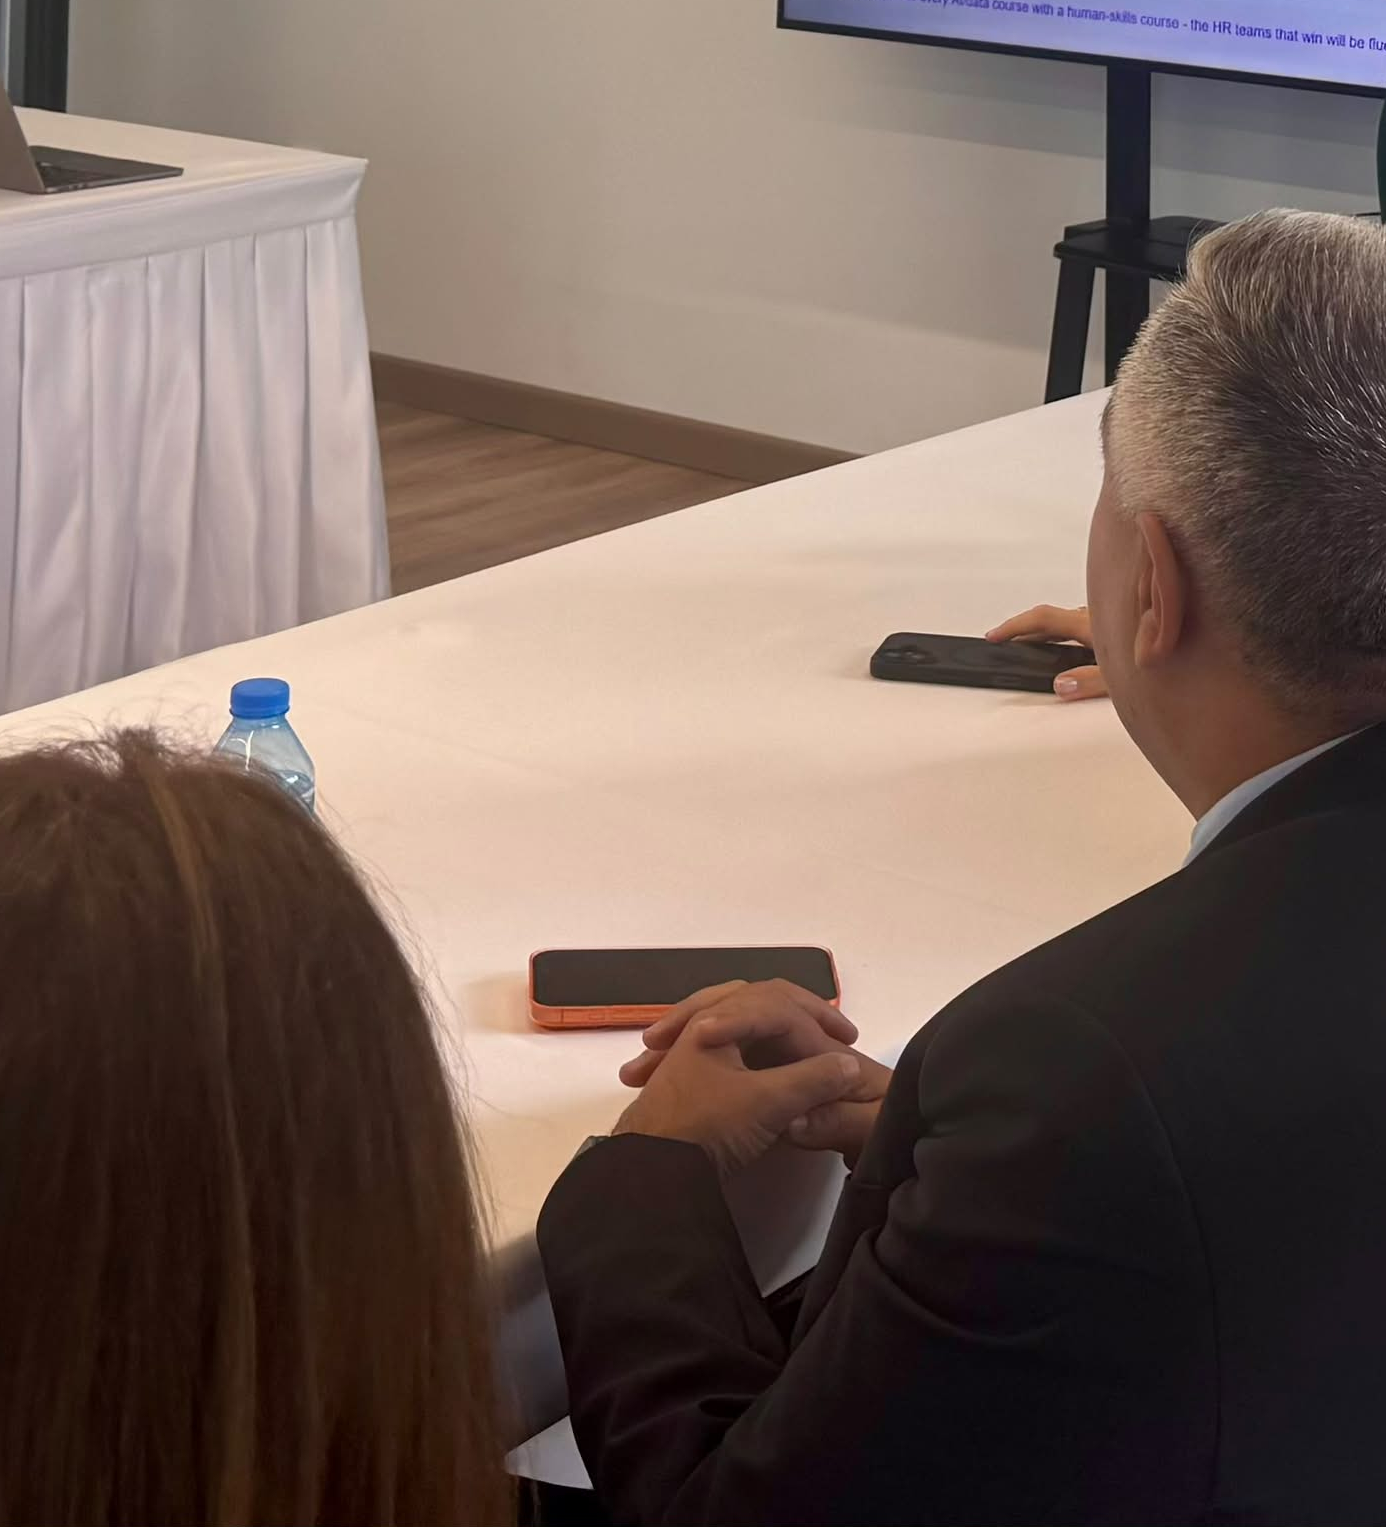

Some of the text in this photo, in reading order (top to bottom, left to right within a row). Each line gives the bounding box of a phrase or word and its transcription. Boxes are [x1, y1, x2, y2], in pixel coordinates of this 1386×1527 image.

[992, 0, 1029, 13] course
[1032, 4, 1053, 16] with
[1057, 6, 1064, 17] a
[1067, 6, 1137, 24] human-skills
[1140, 15, 1179, 29] course
[1190, 19, 1209, 32] the
[1213, 20, 1231, 35] HR
[1235, 24, 1272, 39] teams
[1275, 28, 1298, 42] that
[1301, 33, 1323, 44] win
[1349, 35, 1365, 49] be
